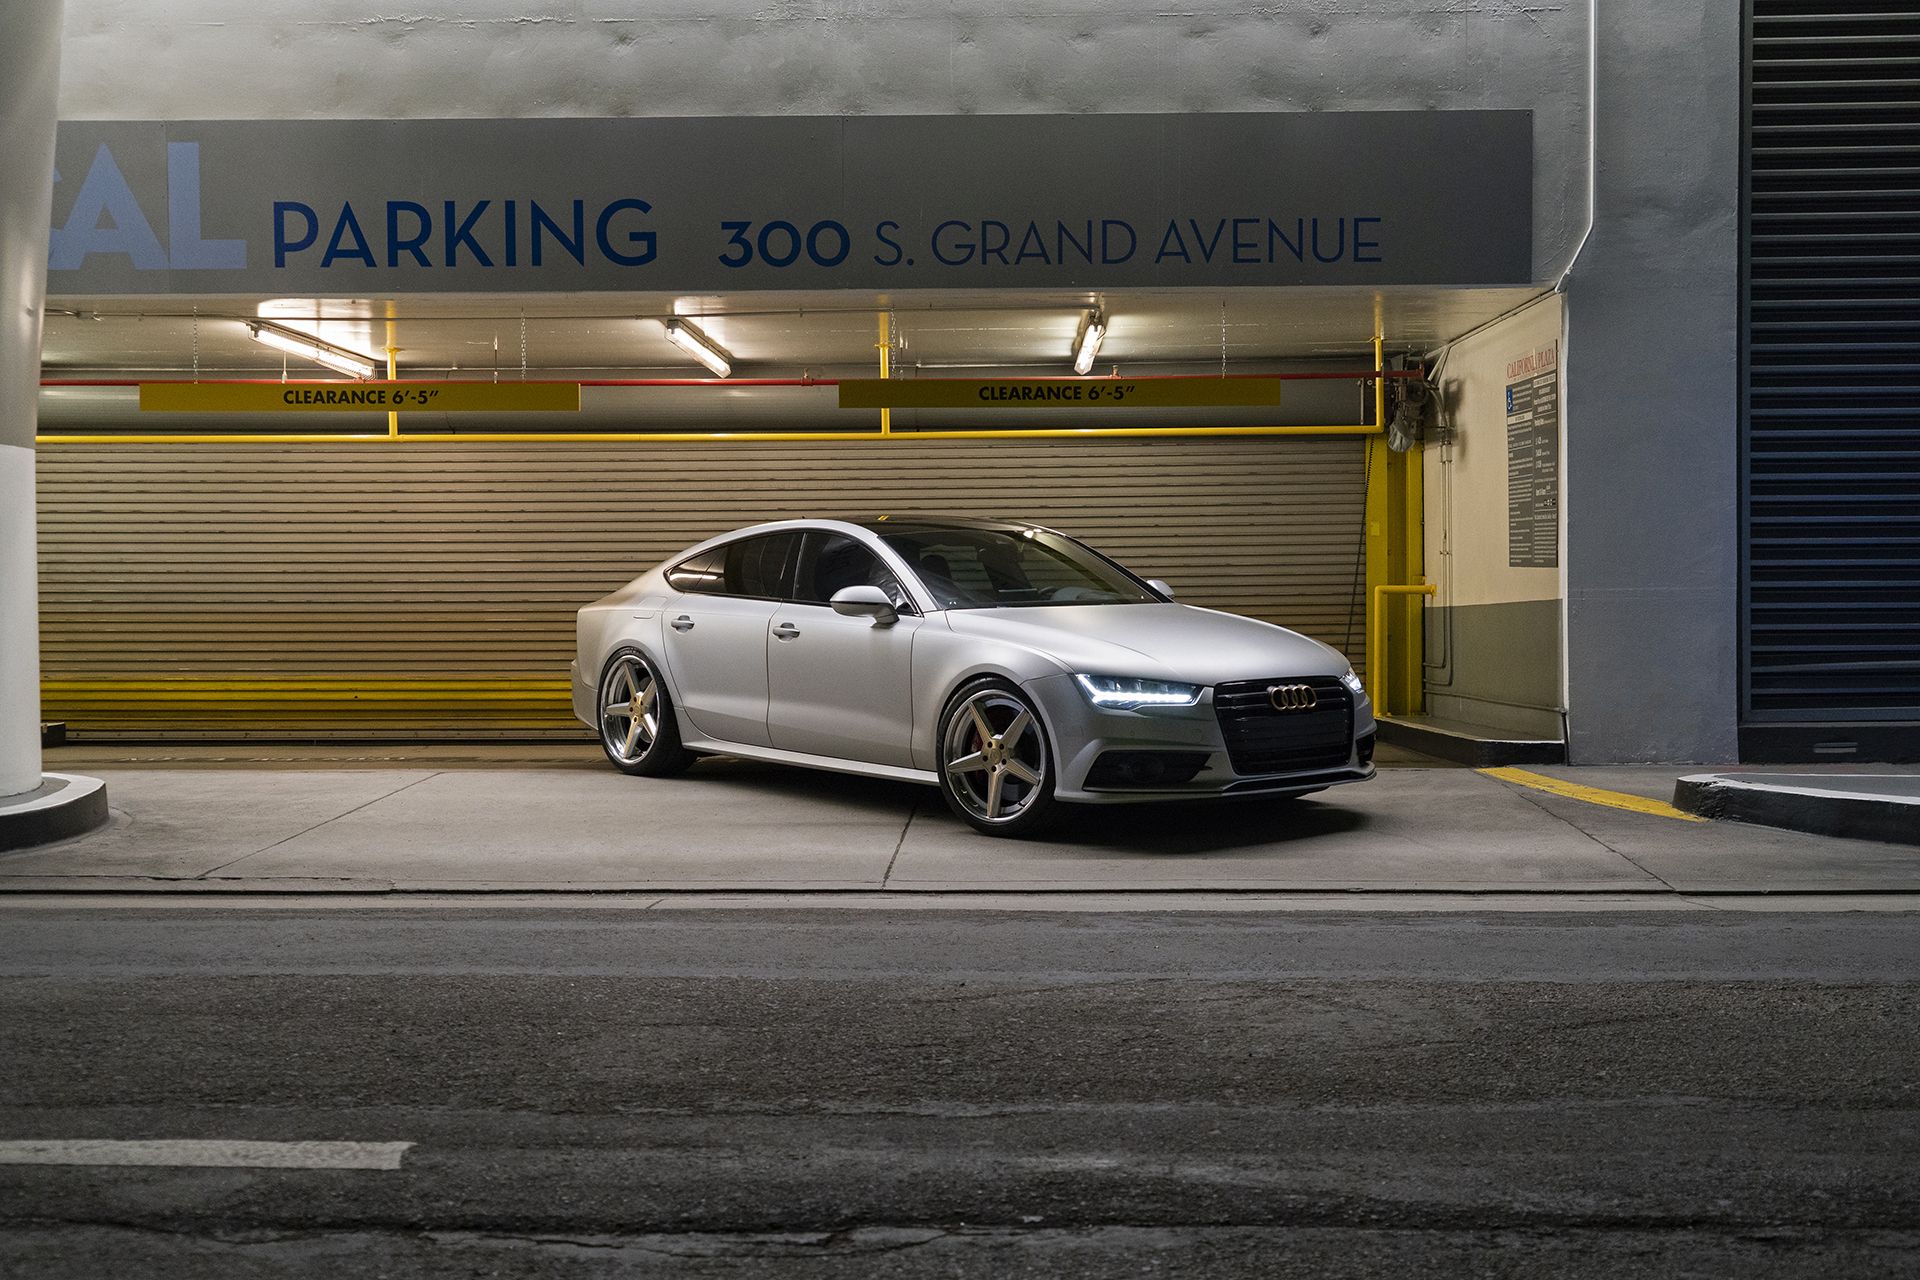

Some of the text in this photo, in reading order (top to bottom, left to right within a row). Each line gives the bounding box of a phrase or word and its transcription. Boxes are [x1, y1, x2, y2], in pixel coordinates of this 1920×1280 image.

[48, 142, 658, 270] AL PARKING
[718, 217, 1382, 268] 300 S. GRAND AVENUE
[283, 390, 439, 405] CLEARANCE 6'-5"
[978, 385, 1135, 401] CLEARANCE 6'-5"
